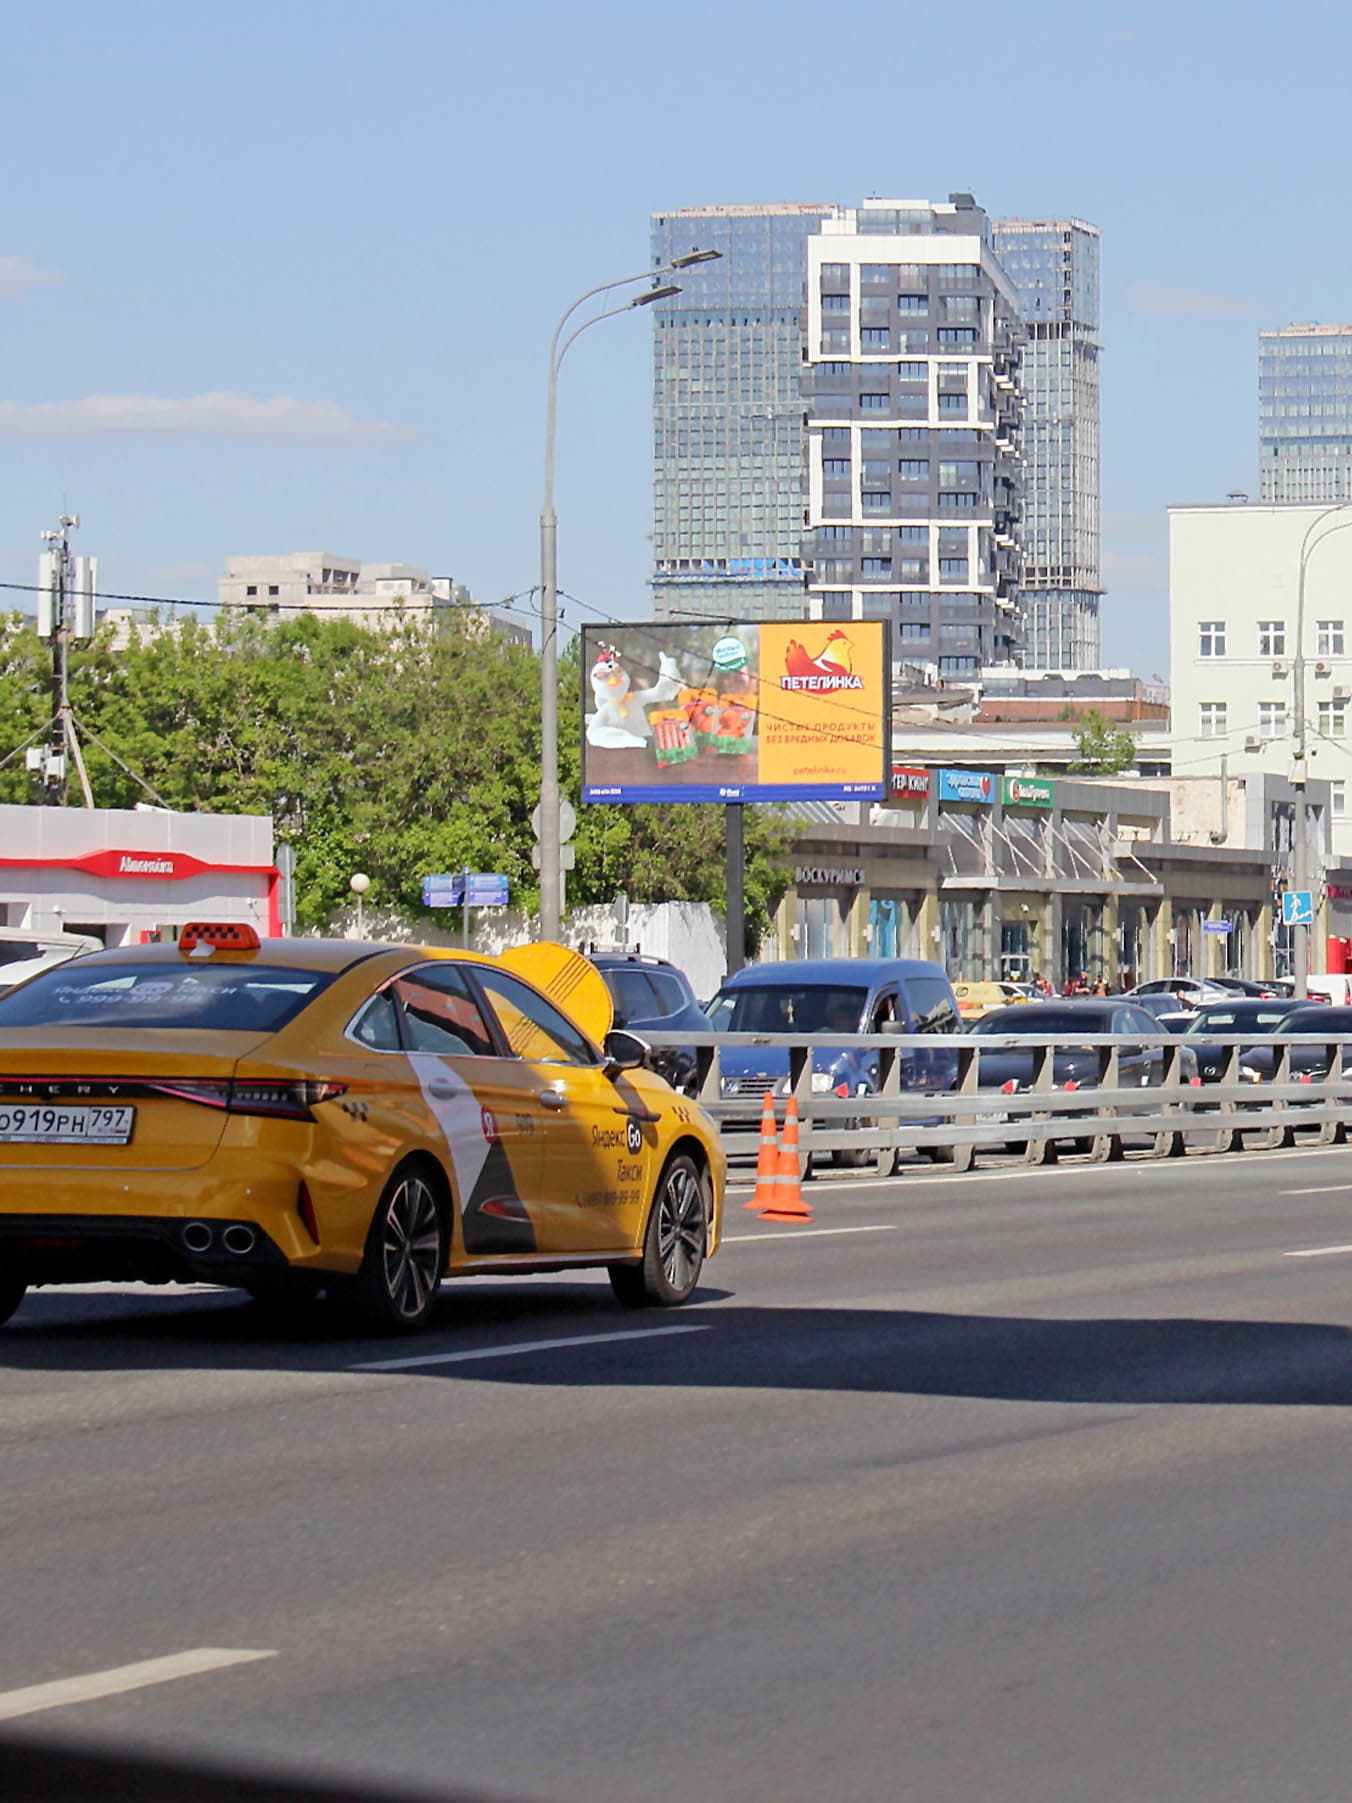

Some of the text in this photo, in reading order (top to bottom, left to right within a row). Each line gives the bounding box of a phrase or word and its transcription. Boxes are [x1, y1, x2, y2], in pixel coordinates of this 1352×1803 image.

[781, 675, 863, 690] ПЕТЕЛИНКА
[814, 722, 876, 733] ПРОДУКТЫ
[766, 735, 782, 744] БЕЗ
[785, 735, 827, 744] ВРЕДНЫХ
[0, 1085, 119, 1094] HERY
[592, 1123, 641, 1149] Яндекс Go
[617, 1159, 642, 1182] Такси
